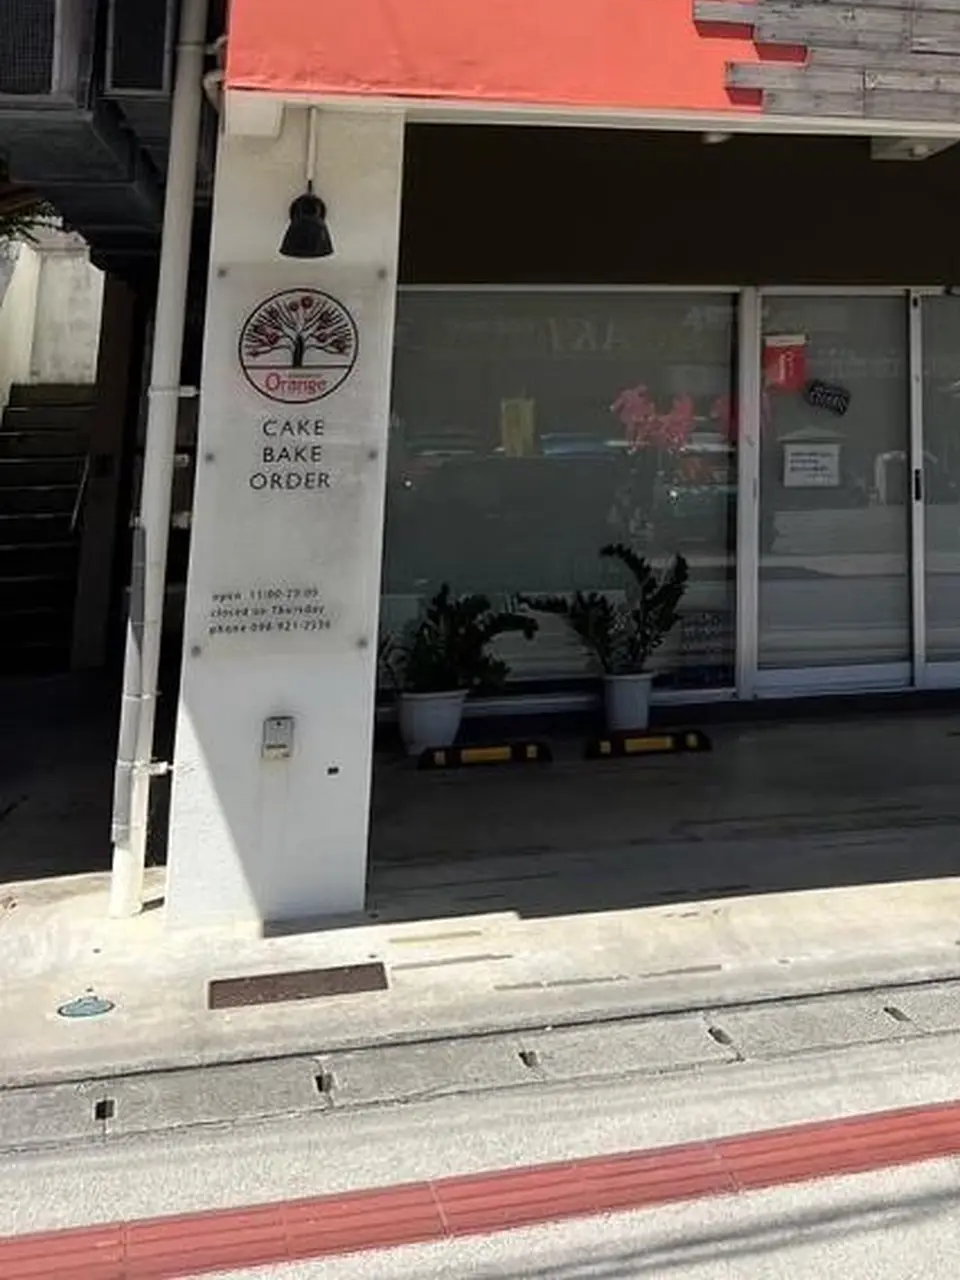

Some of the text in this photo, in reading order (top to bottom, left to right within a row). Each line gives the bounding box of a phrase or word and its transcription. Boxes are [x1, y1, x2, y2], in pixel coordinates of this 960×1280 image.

[265, 372, 327, 395] Orange
[262, 419, 325, 437] CAKE
[262, 445, 323, 464] BAKE
[249, 472, 332, 491] ORDER
